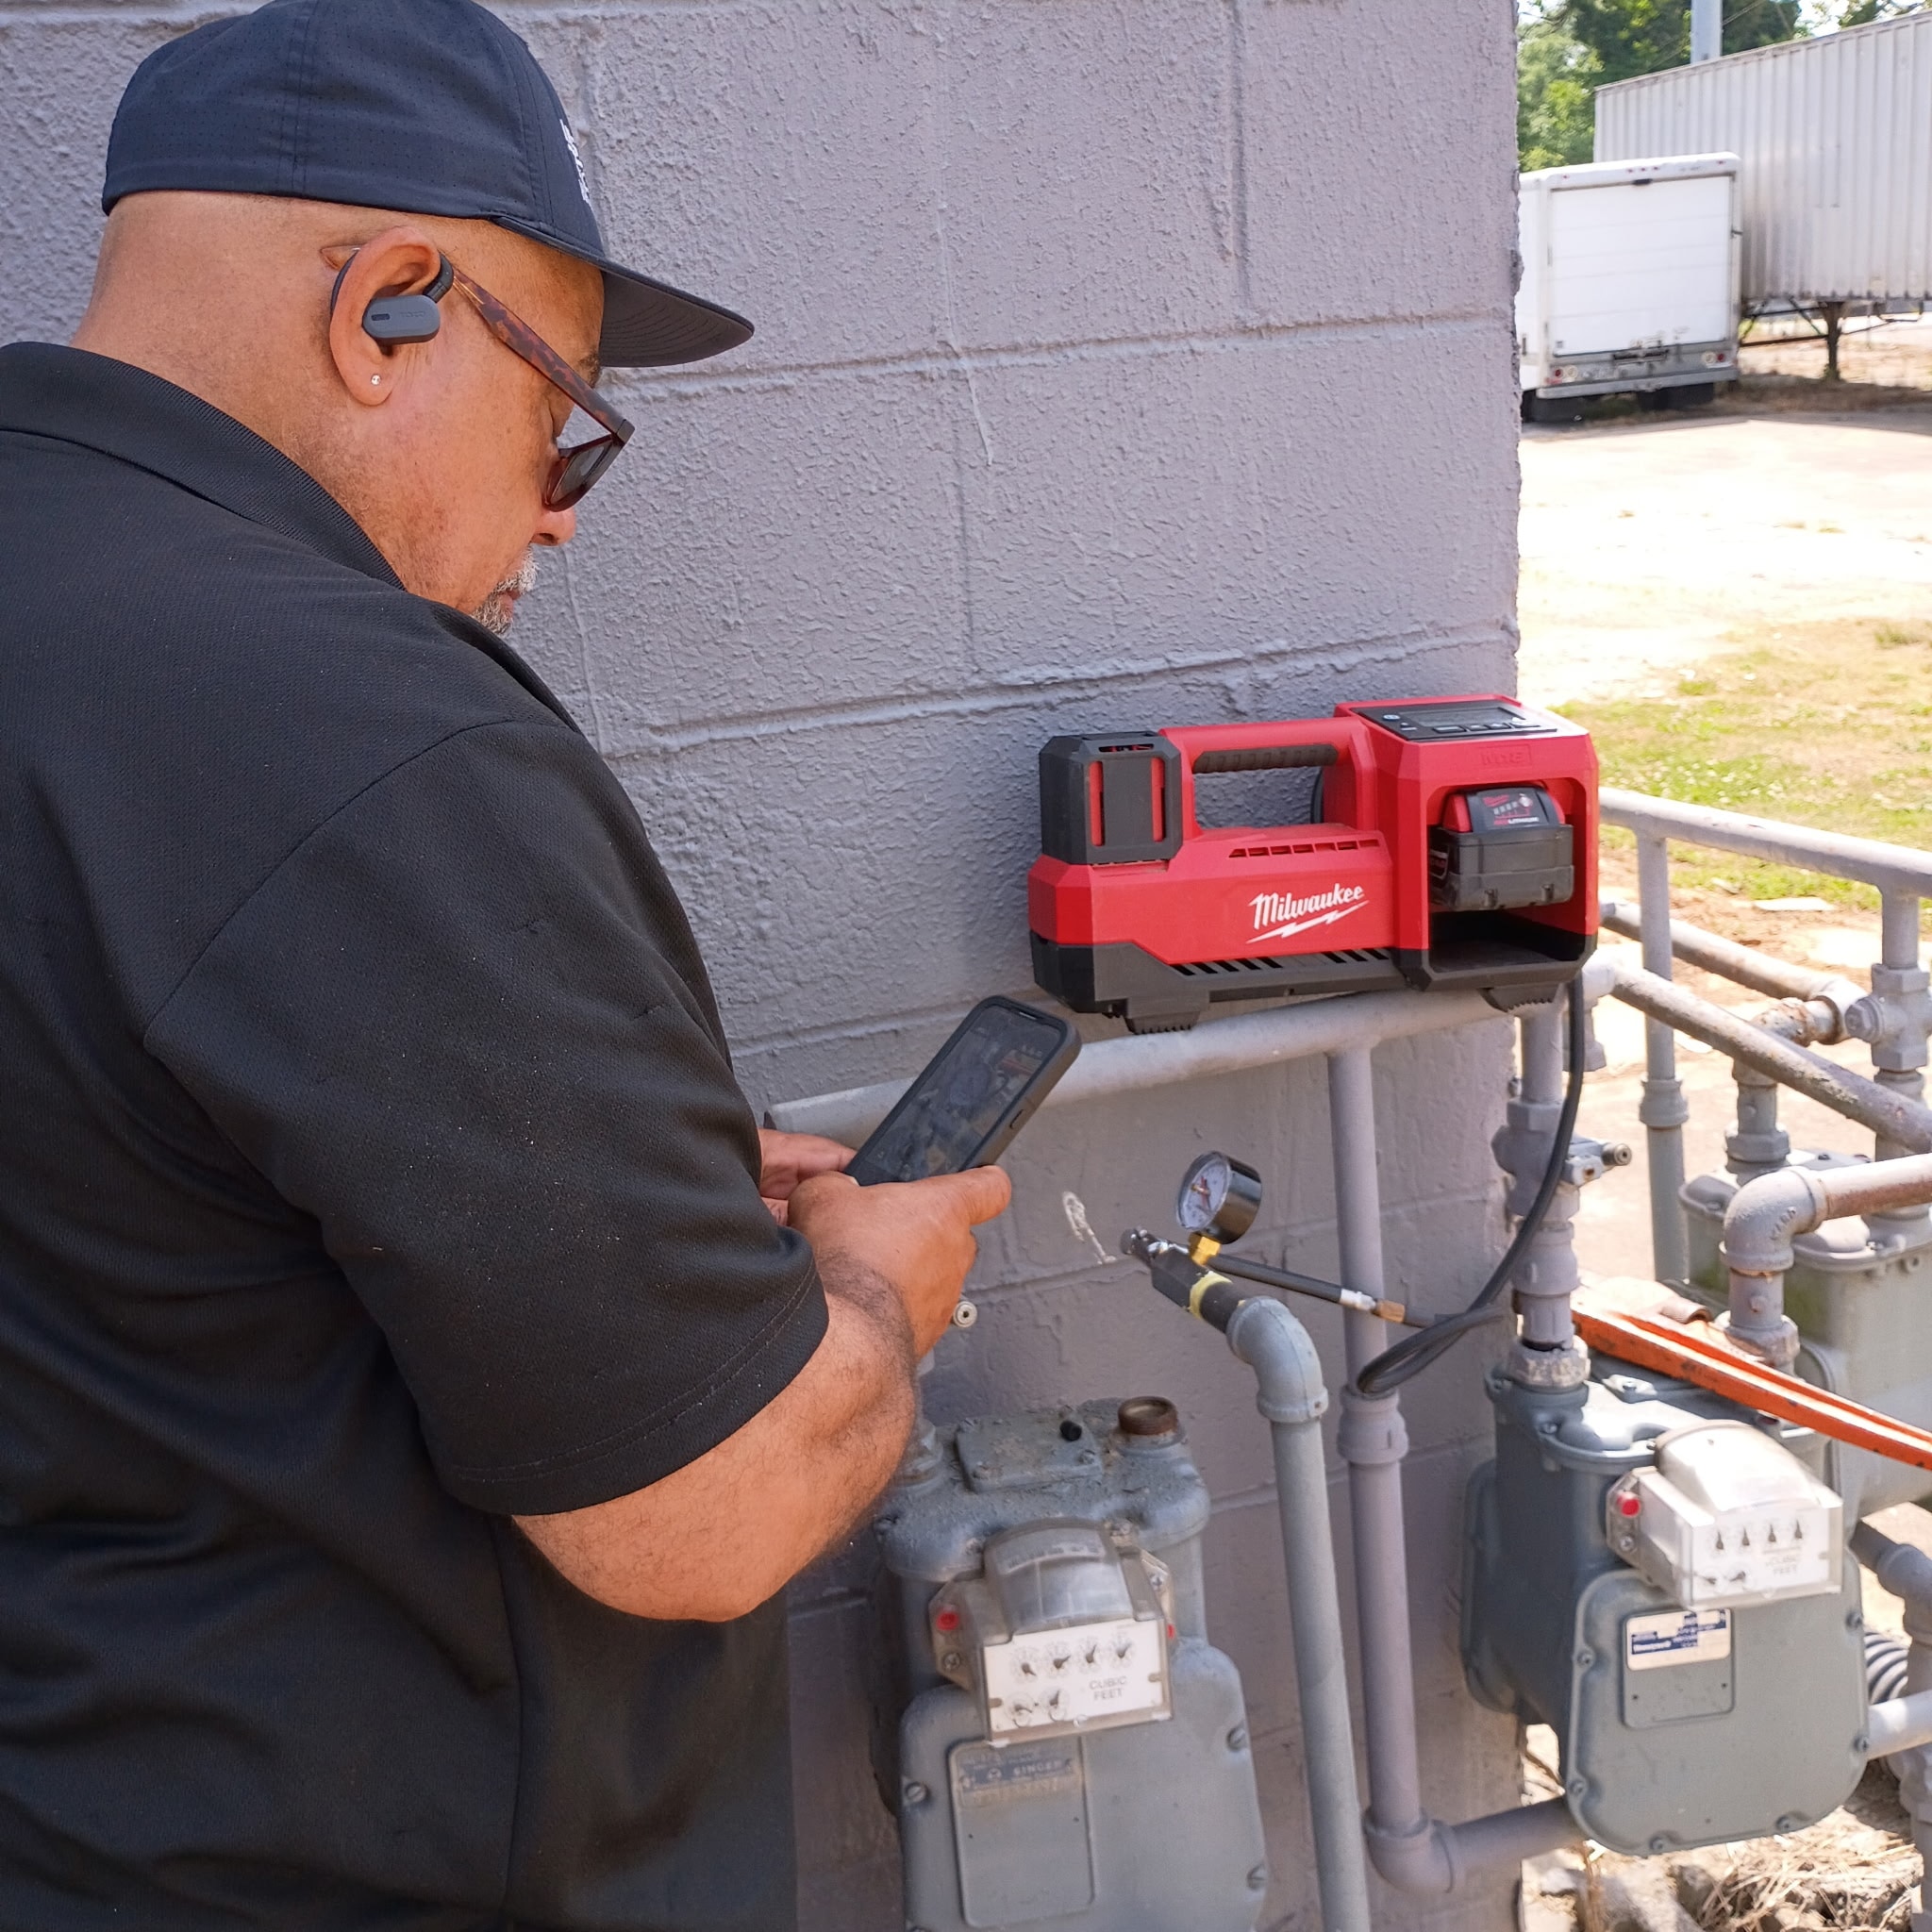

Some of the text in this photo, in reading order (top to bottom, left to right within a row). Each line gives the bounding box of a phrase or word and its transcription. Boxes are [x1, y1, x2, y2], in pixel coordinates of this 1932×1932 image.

[1247, 883, 1364, 930] Milwaukee
[1089, 1675, 1127, 1690] CUBIC
[1093, 1688, 1124, 1701] FEET
